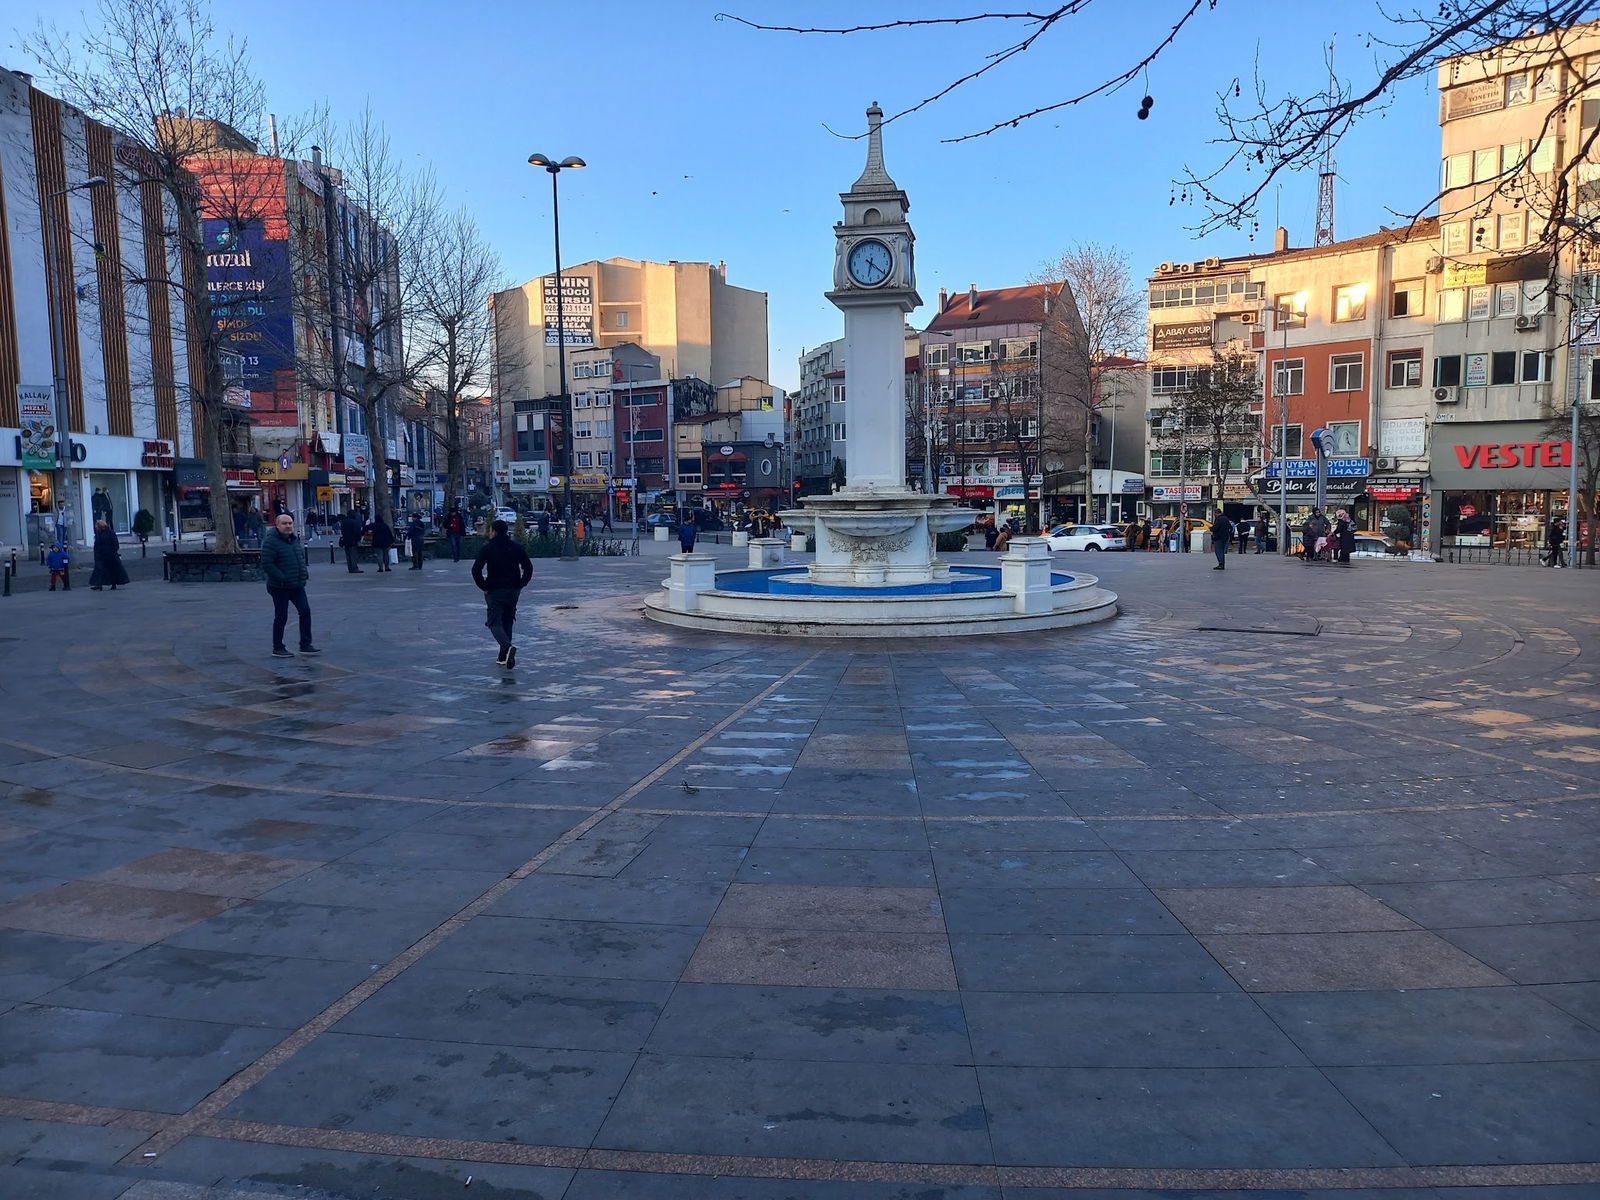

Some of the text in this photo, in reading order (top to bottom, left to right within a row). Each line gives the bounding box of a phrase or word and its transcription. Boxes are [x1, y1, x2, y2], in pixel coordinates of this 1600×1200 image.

[544, 277, 589, 288] EMİN
[1166, 326, 1210, 336] ABAY GRUP
[1454, 441, 1583, 469] VESTEL
[1281, 458, 1366, 469] UYSAN DYOLOJİ
[1326, 468, 1366, 476] İHAZI
